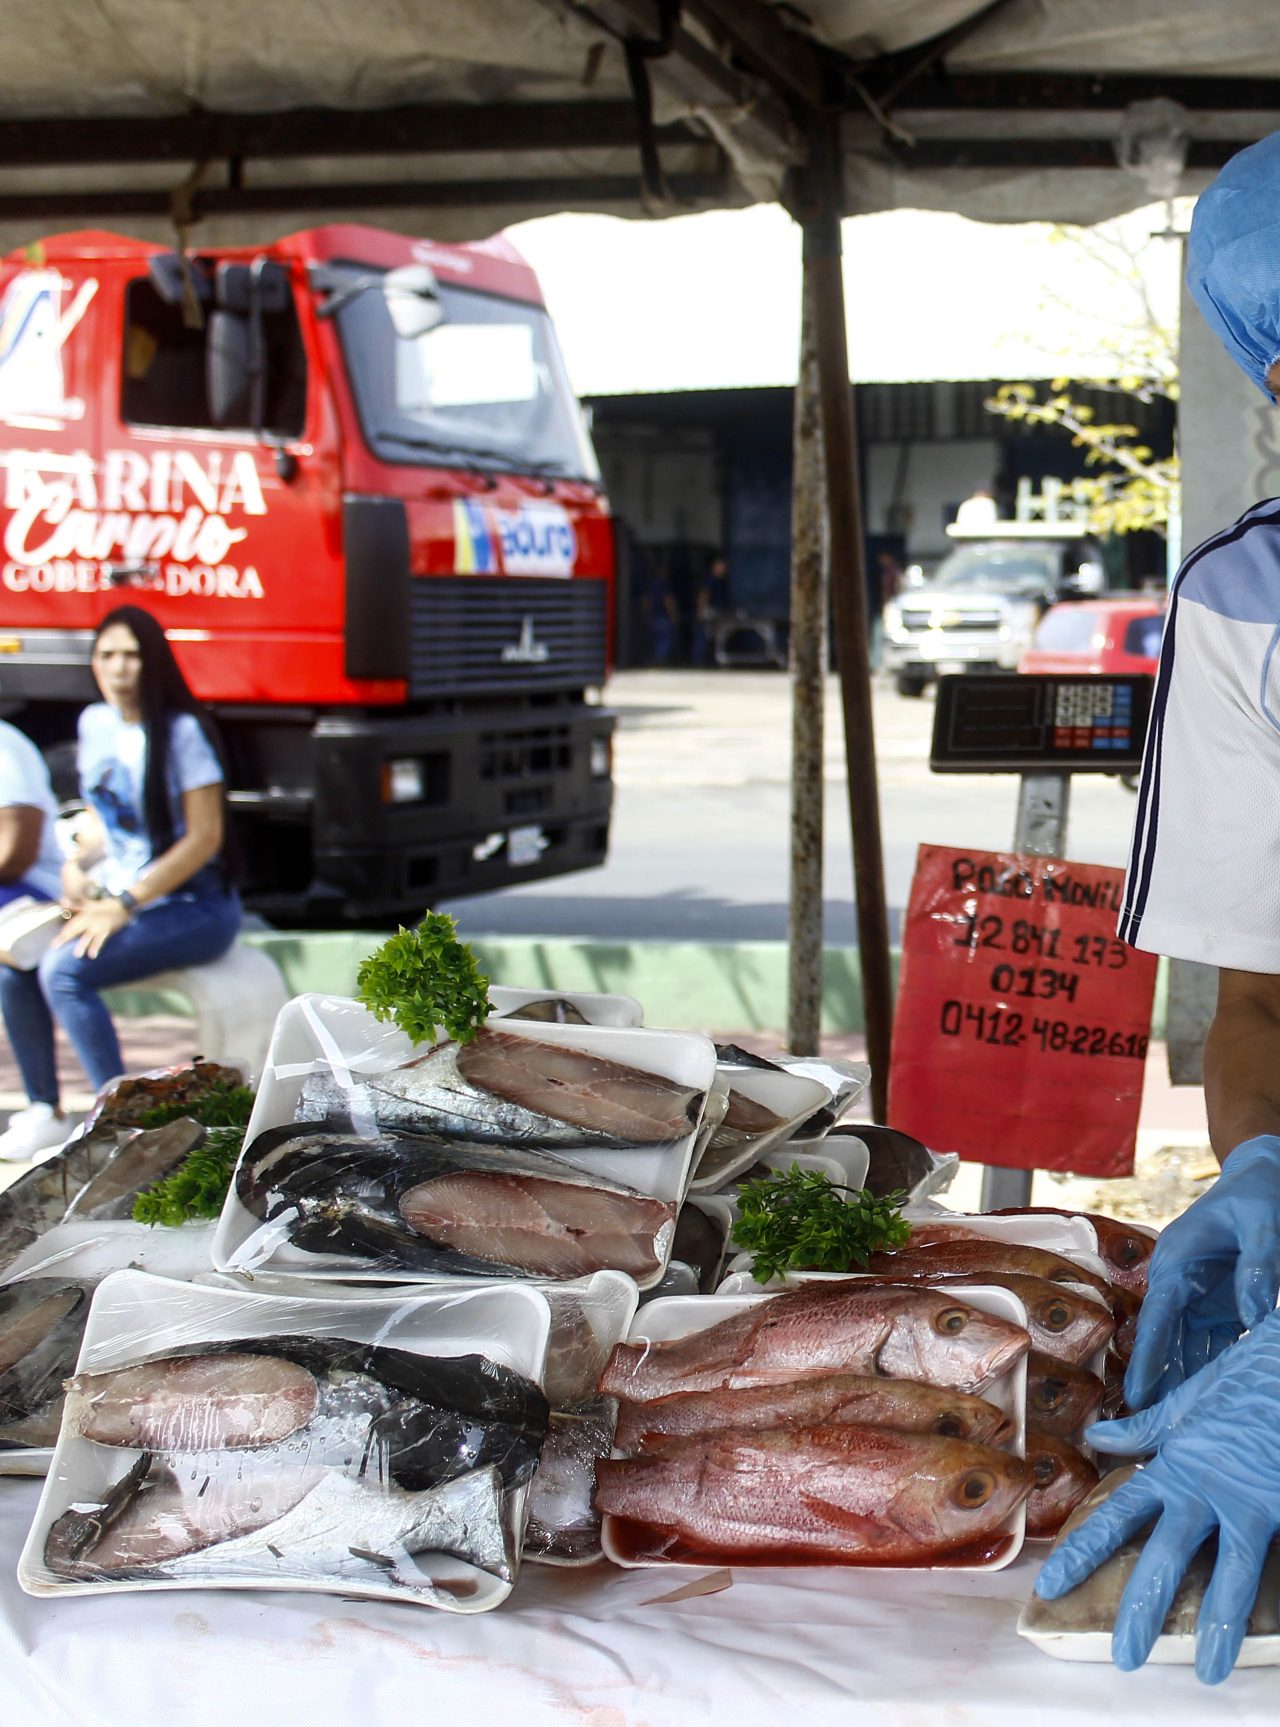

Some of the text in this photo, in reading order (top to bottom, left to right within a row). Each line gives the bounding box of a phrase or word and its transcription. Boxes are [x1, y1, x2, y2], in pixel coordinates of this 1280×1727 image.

[4, 481, 248, 568] Carpio
[3, 560, 264, 599] GOBEDORA
[989, 963, 1079, 1004] 0134
